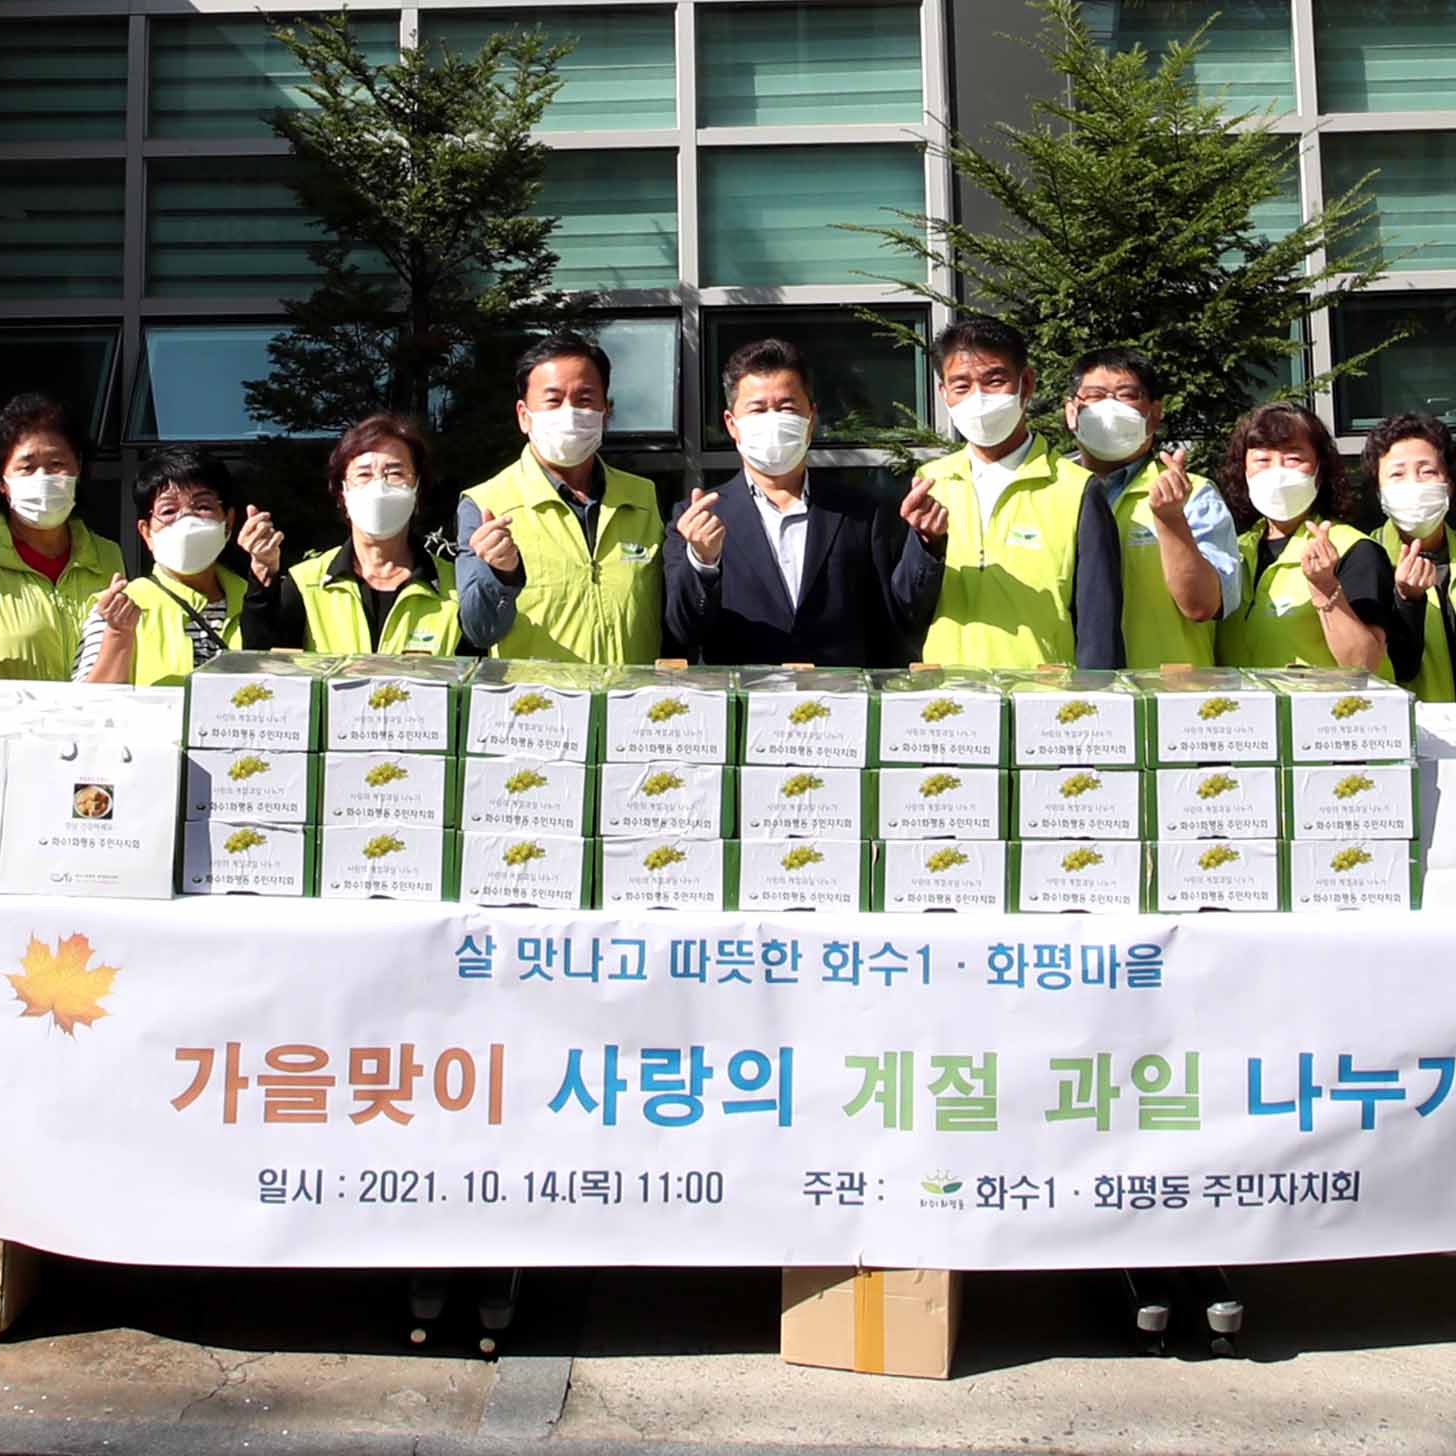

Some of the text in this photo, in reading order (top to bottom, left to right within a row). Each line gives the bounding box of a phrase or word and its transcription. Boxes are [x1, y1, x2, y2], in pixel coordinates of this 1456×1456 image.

[455, 936, 497, 980] 살
[518, 937, 647, 984] 맛나고
[669, 937, 800, 985] 따뜻한
[821, 942, 932, 987] 화수1
[986, 942, 1165, 991] 화평마을
[170, 1041, 506, 1126] 가을맞이
[547, 1043, 794, 1128] 사랑의
[843, 1050, 1000, 1132] 계절
[1044, 1050, 1202, 1132] 과일
[258, 1168, 324, 1205] 일시
[358, 1170, 448, 1204] 2021.
[463, 1170, 508, 1204] 10.
[638, 1170, 724, 1205] 11:00
[803, 1170, 867, 1207] 주관
[975, 1173, 1056, 1211] 화수1
[1094, 1172, 1189, 1211] 화평동
[1202, 1169, 1361, 1208] 주민자치회
